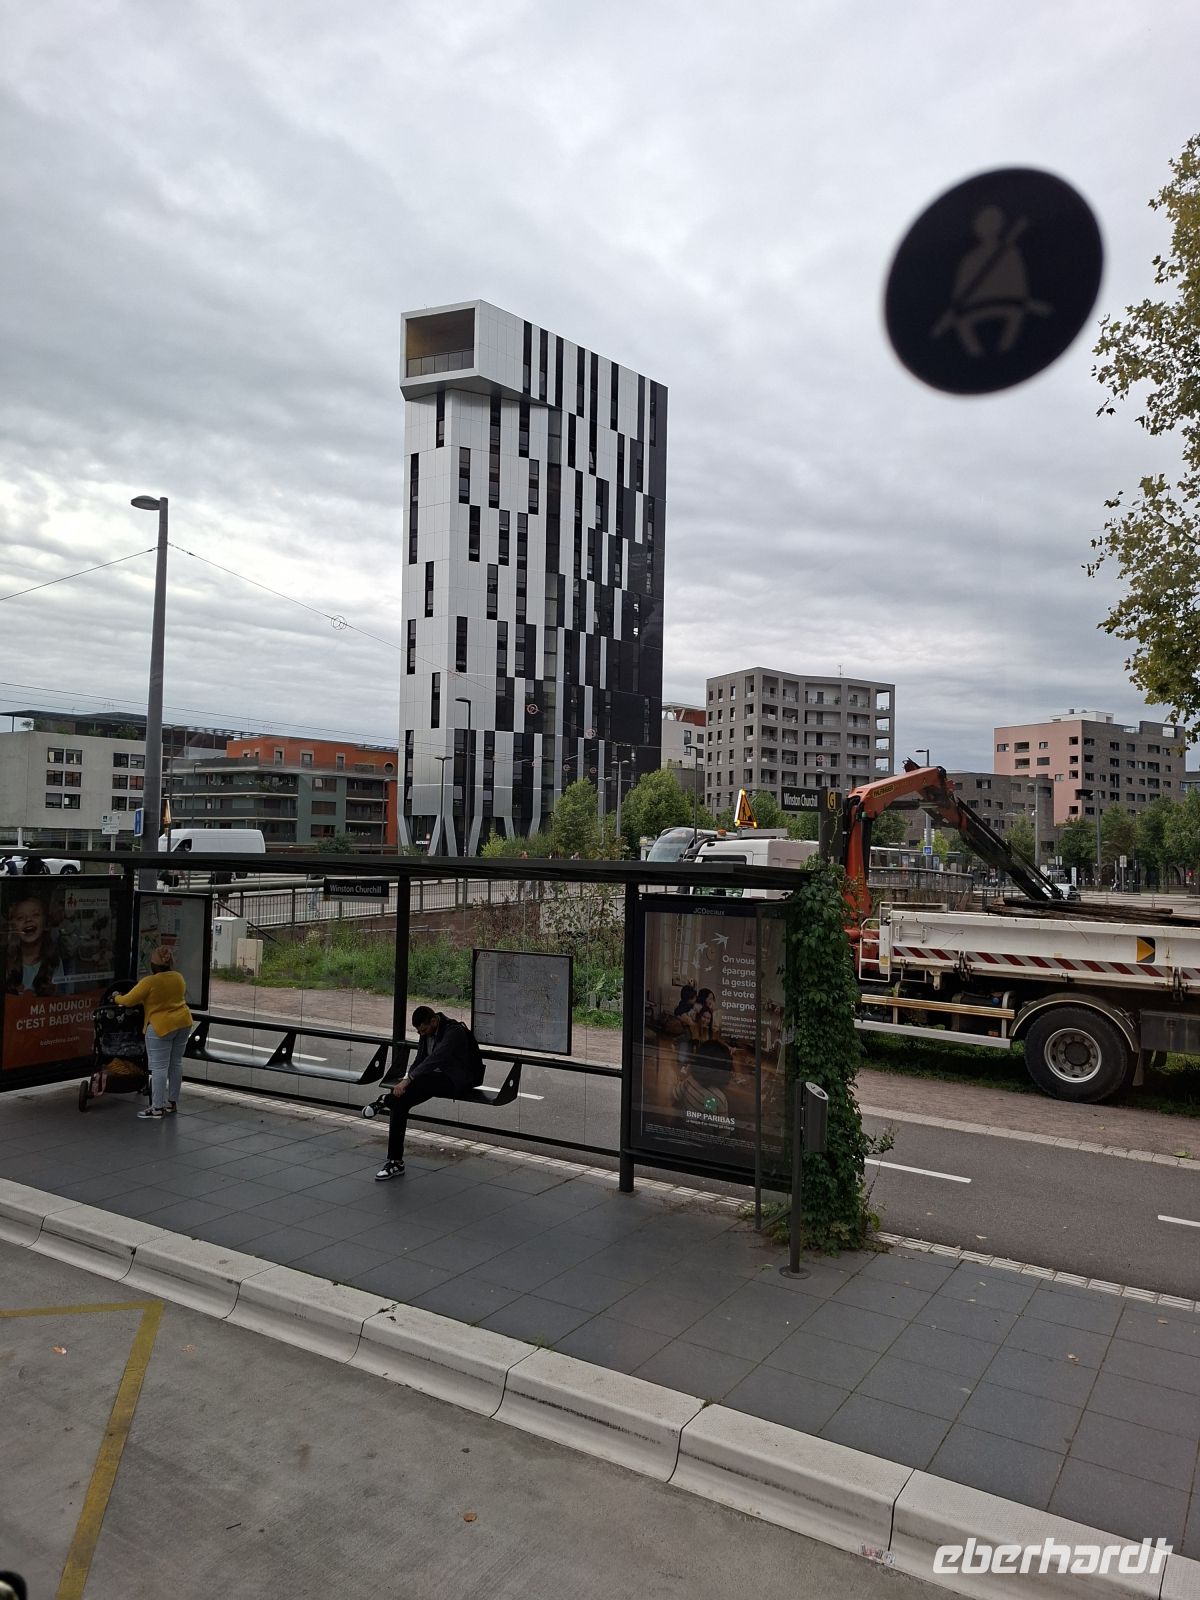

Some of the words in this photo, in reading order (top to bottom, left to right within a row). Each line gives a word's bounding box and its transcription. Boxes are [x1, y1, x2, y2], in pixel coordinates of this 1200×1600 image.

[784, 792, 800, 805] Winston
[801, 794, 818, 806] Churchill
[829, 792, 835, 808] G
[330, 885, 354, 893] Winston
[355, 886, 382, 894] Churchill
[693, 907, 725, 915] JCDecaux
[722, 954, 735, 963] On
[722, 965, 756, 977] épargne
[722, 977, 730, 985] la
[731, 978, 757, 988] gestio
[721, 988, 732, 996] de
[733, 991, 755, 999] votre
[30, 1003, 46, 1016] MA
[49, 999, 91, 1013] NOUNOU
[16, 1017, 46, 1031] C'EST
[686, 1110, 702, 1119] BNP
[703, 1113, 736, 1125] PARIBAS
